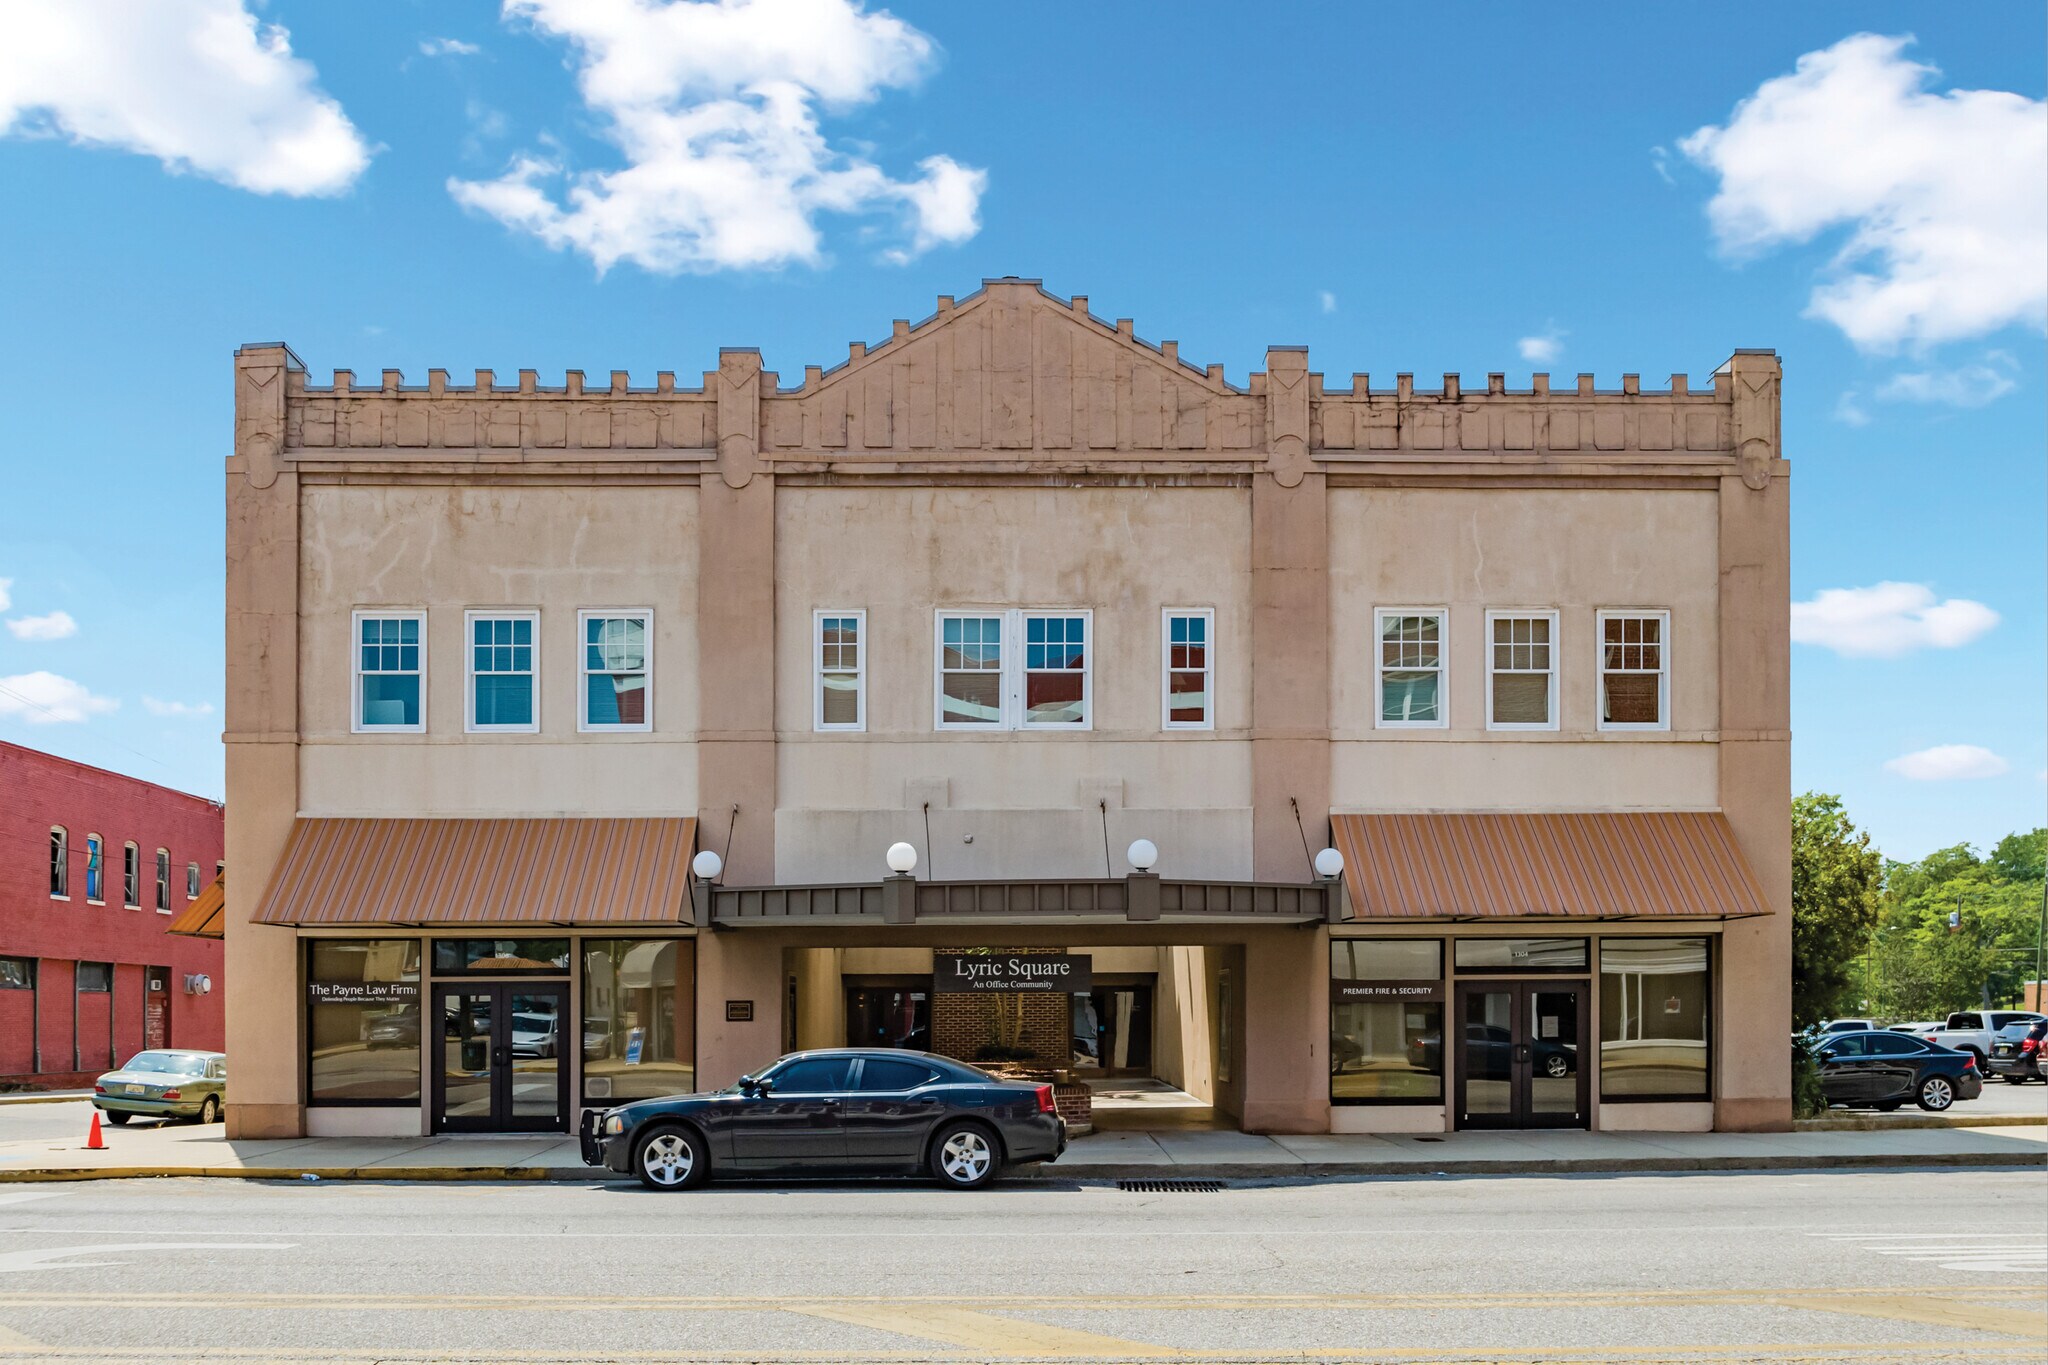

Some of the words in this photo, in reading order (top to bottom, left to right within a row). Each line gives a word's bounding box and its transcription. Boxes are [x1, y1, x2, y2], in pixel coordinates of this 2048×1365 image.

[955, 959, 1002, 980] Lyric
[1008, 958, 1070, 980] Square
[310, 984, 329, 995] The
[332, 984, 363, 996] Payne
[366, 984, 387, 995] Law
[391, 984, 413, 995] Firm
[986, 980, 1009, 989] Office
[1010, 981, 1053, 990] Community
[1343, 987, 1374, 995] PREMIER
[1375, 987, 1391, 995] FIRE
[1399, 987, 1433, 995] SECURITY
